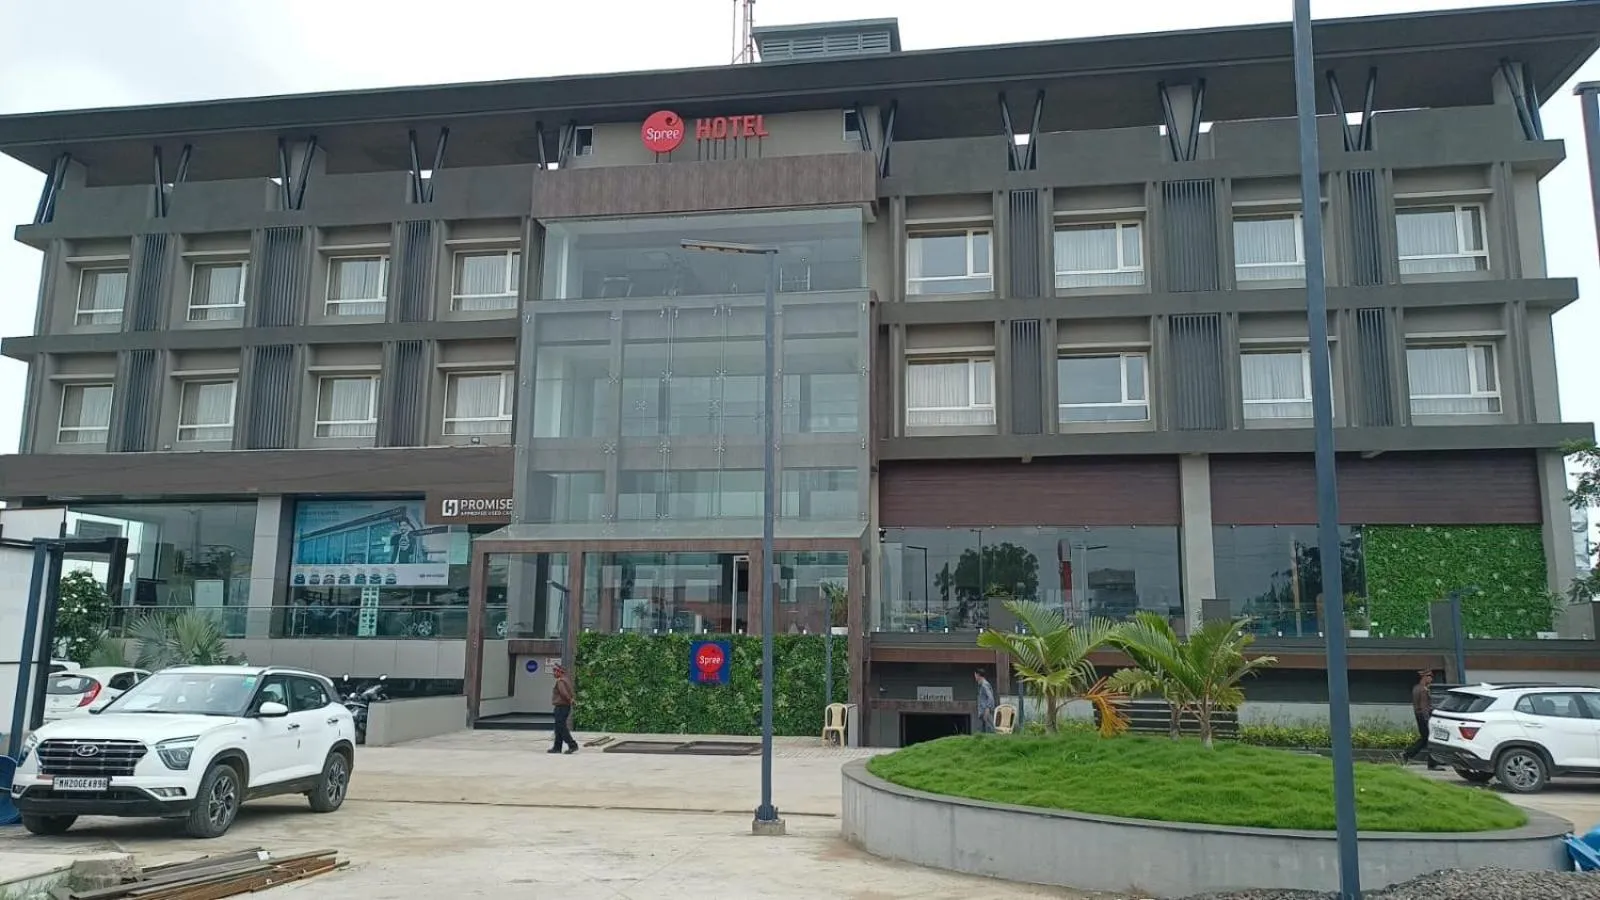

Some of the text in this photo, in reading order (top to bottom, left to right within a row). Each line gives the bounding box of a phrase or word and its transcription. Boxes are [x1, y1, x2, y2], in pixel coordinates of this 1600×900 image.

[646, 114, 769, 142] Spree HOTEL
[460, 498, 513, 510] PROMISE
[699, 655, 721, 666] Spree
